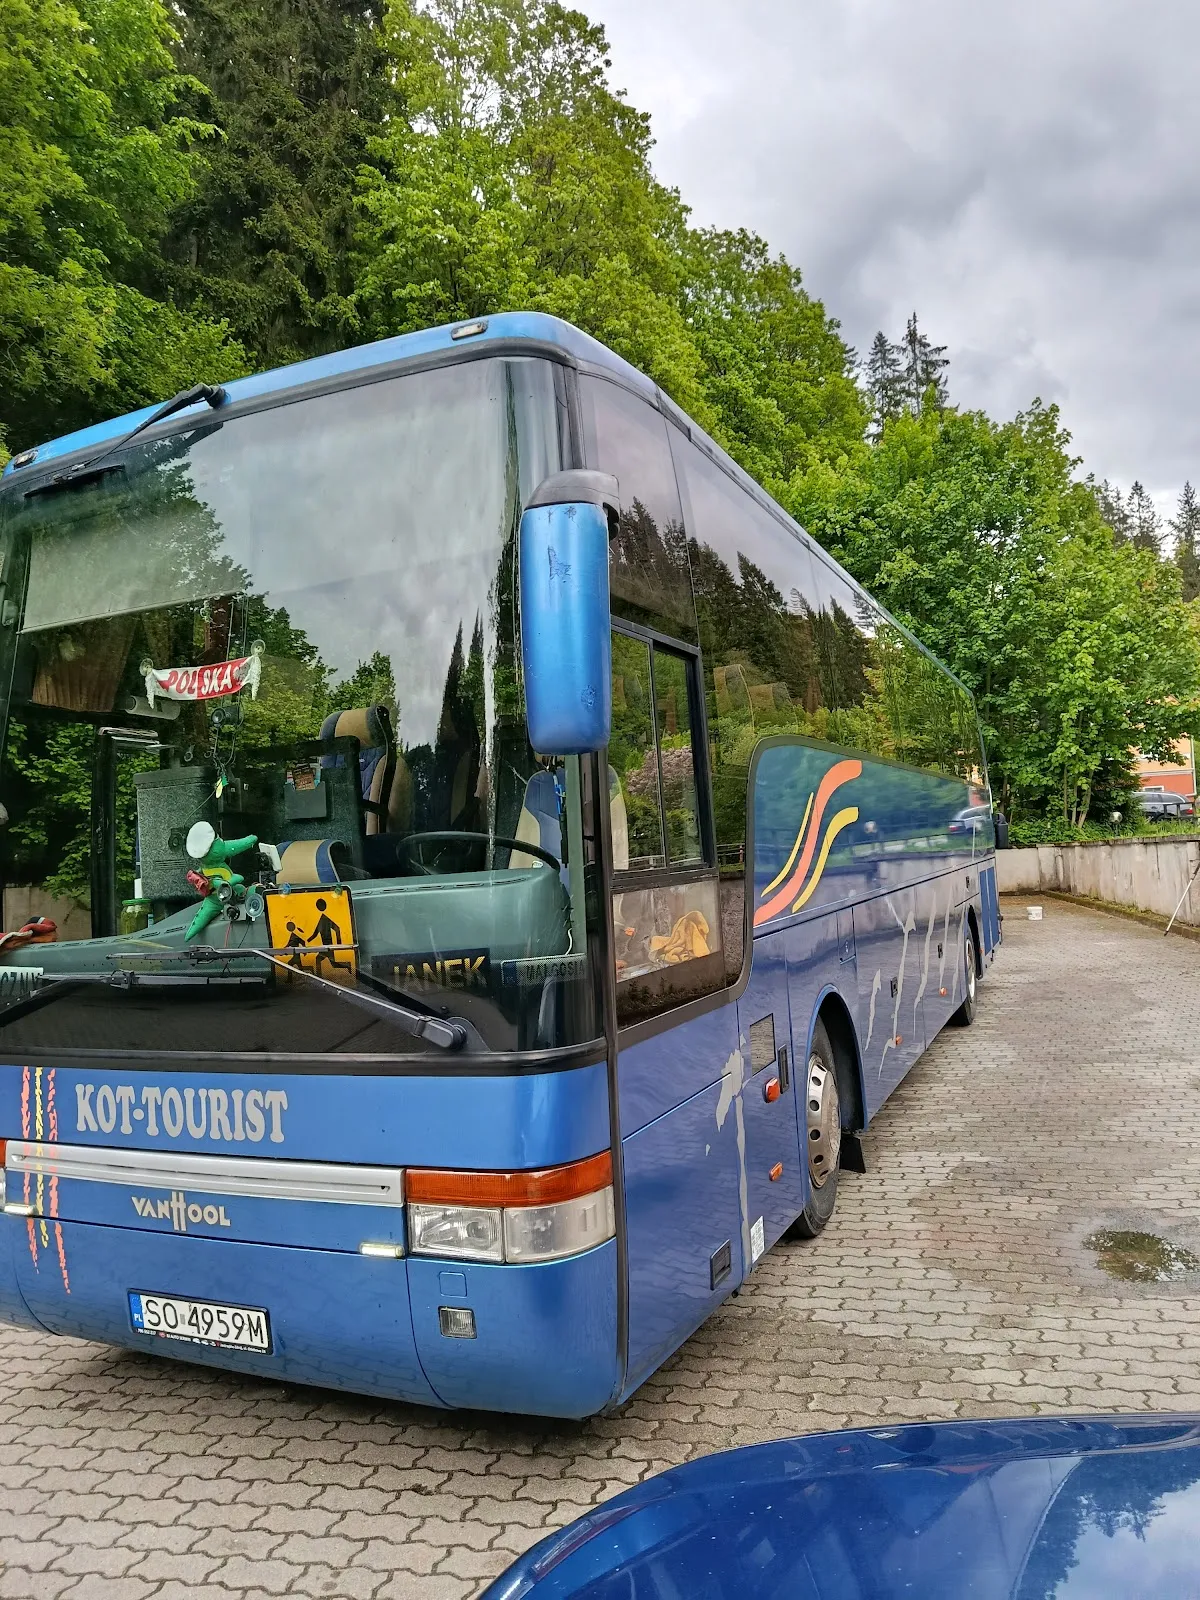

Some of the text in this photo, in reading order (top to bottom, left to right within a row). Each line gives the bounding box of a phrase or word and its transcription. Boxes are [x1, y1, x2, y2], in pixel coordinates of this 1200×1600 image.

[167, 664, 233, 696] POLSKA
[133, 1313, 143, 1322] PL
[145, 1299, 265, 1344] SO 4959M
